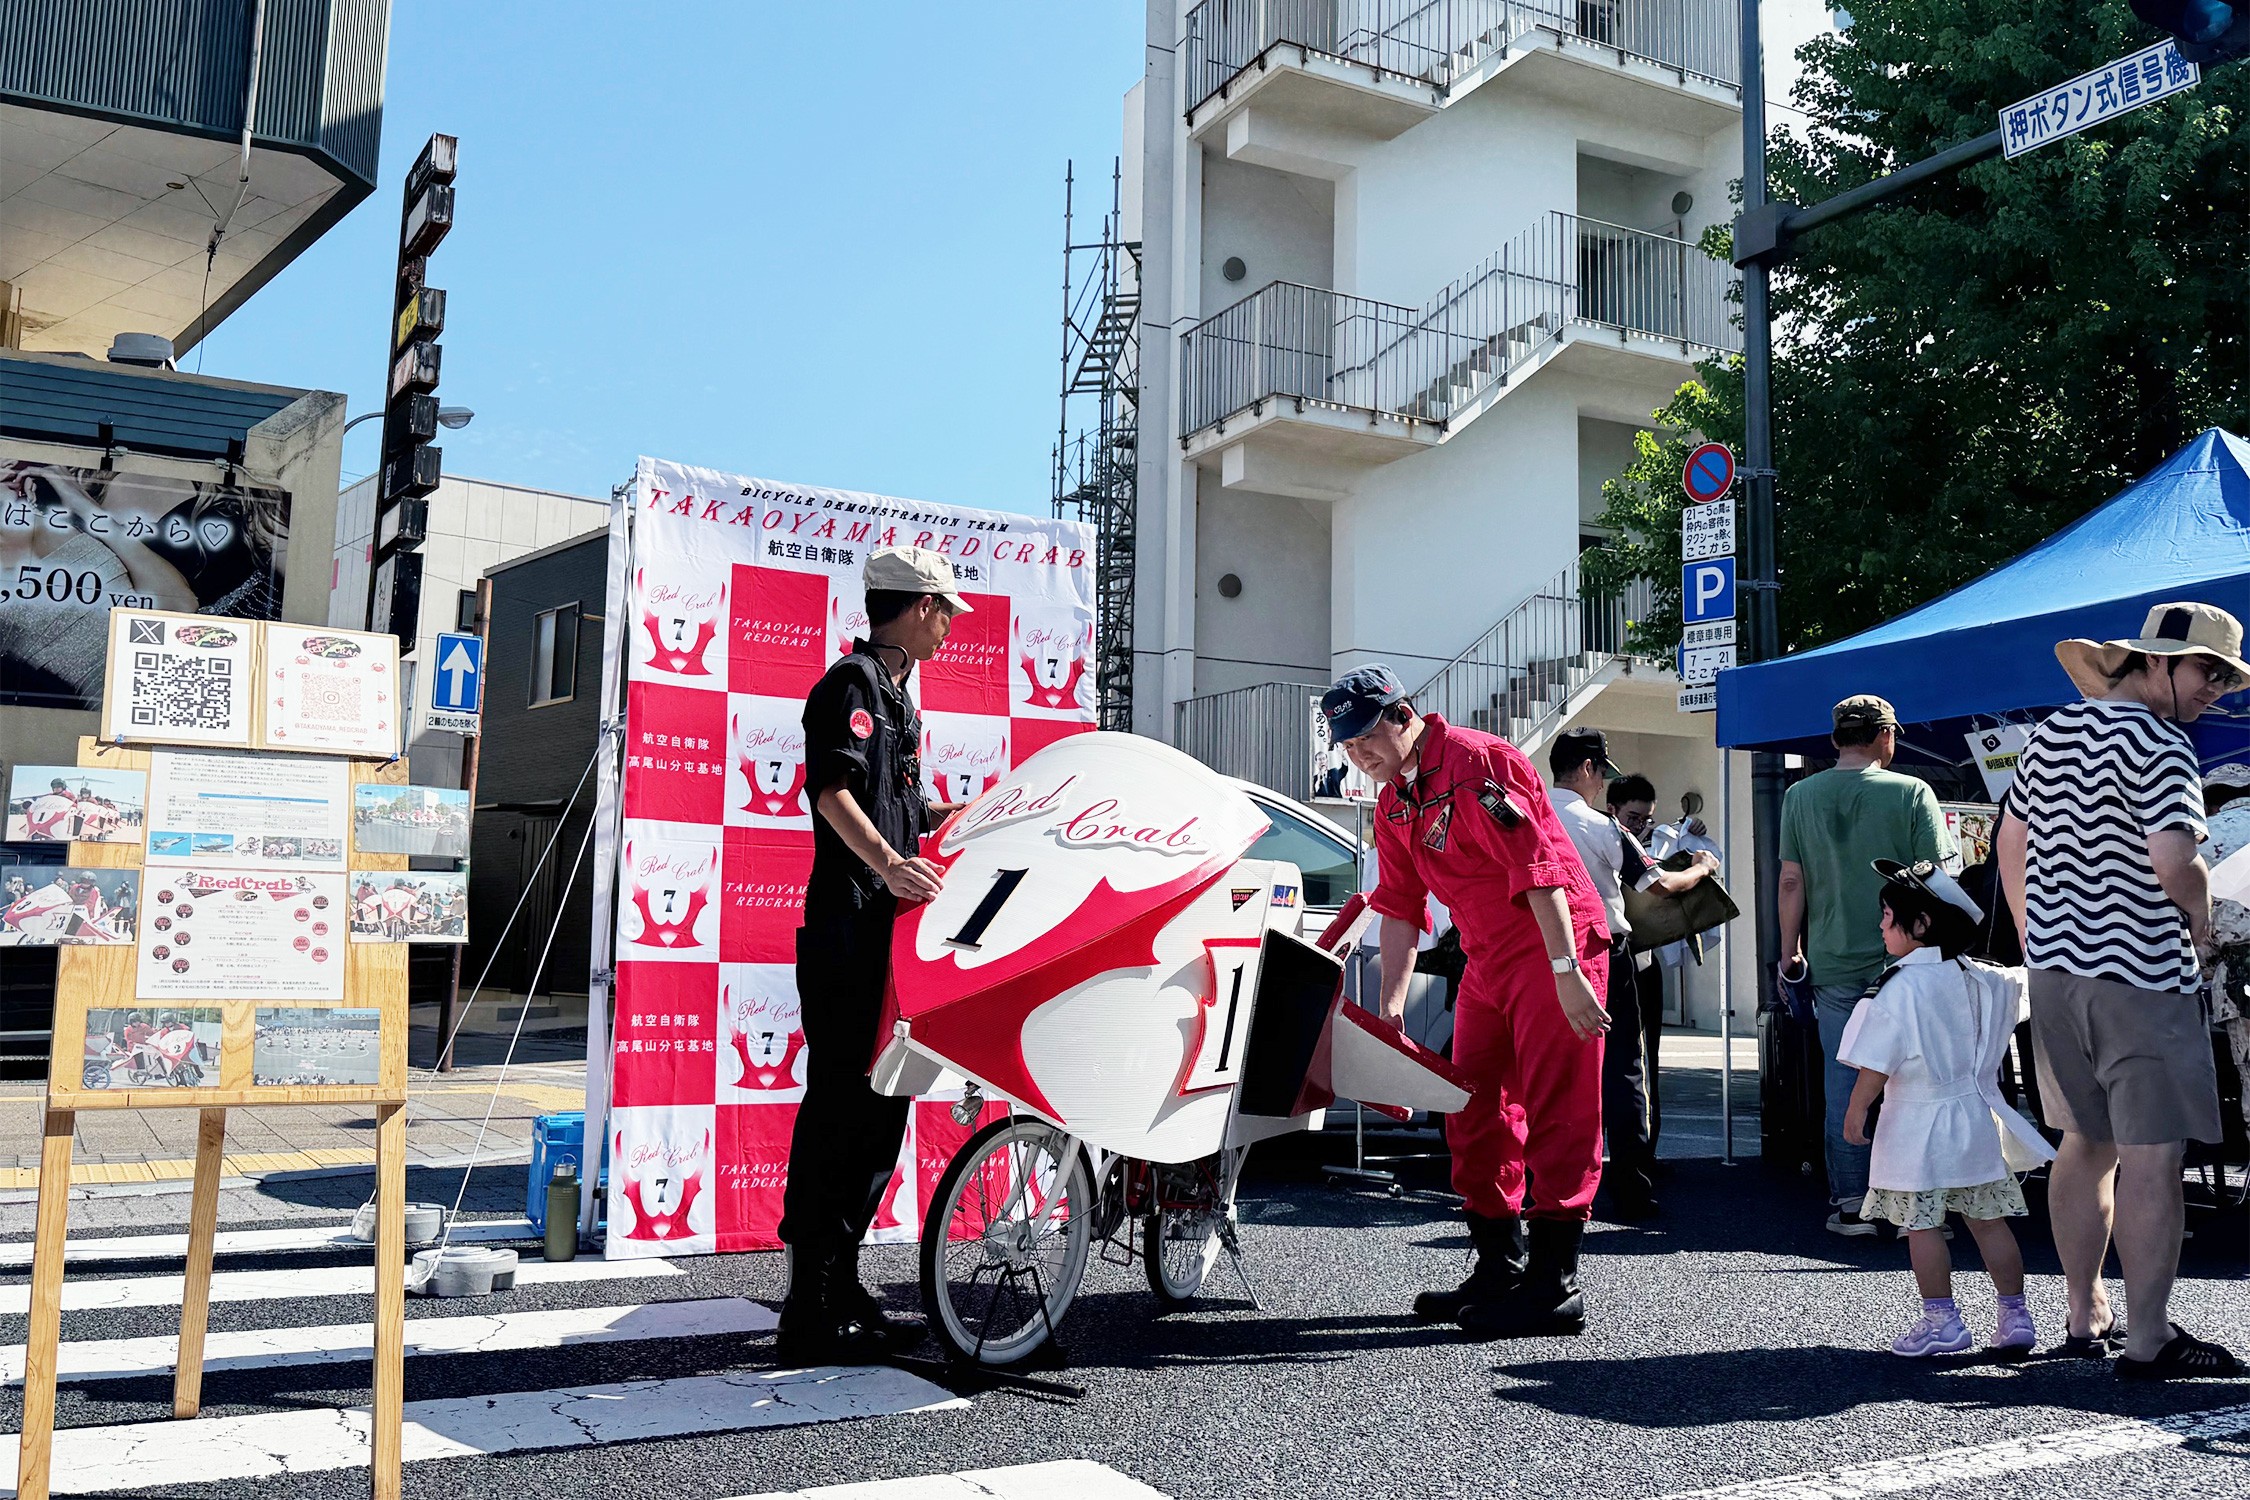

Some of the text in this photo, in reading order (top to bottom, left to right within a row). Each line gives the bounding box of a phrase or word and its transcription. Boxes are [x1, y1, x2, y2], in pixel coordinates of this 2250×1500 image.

[2008, 46, 2190, 149] 押ボタン式信号機
[740, 487, 1010, 532] BICYCLE DEMONSTRATION TEAM
[5, 502, 190, 543] はここから
[647, 488, 1086, 568] TAKAOYAMA RED CRAB
[1686, 516, 1730, 533] 枠内の客待ち
[1686, 529, 1731, 545] タクシーを除く
[768, 539, 854, 566] 航空自衛隊
[1686, 542, 1730, 557] ここから
[108, 593, 153, 610] yen
[650, 585, 716, 611] Red Crab
[1696, 567, 1725, 616] P
[673, 618, 686, 640] 7
[733, 617, 822, 637] TAKAOYAMA
[1687, 626, 1732, 643] 標章車専用
[743, 632, 810, 647] REDCRAB
[1026, 628, 1086, 651] Red Crab
[933, 654, 993, 666] REDCRAB
[1047, 659, 1059, 678] 7
[642, 732, 710, 750] 航空自衛隊
[746, 728, 805, 753] Red Cra
[628, 756, 723, 775] 高尾山分屯基地
[939, 743, 998, 767] Red Crab
[769, 761, 782, 783] 7
[960, 775, 971, 795] 7
[952, 775, 1199, 847] Red Crab
[640, 854, 707, 880] Red Crab
[198, 875, 293, 891] RedCrab
[725, 882, 808, 896] TAKAOYAM
[663, 890, 676, 912] 7
[946, 867, 1029, 949] 1
[737, 997, 769, 1021] Red
[1214, 961, 1244, 1073] 1
[631, 1014, 700, 1027] 航空自衛隊
[616, 1040, 714, 1053] 高尾山分屯基地
[761, 1032, 774, 1054] 7
[631, 1141, 700, 1168] Red Crab
[655, 1178, 669, 1203] 7
[731, 1176, 788, 1189] REDCRA
